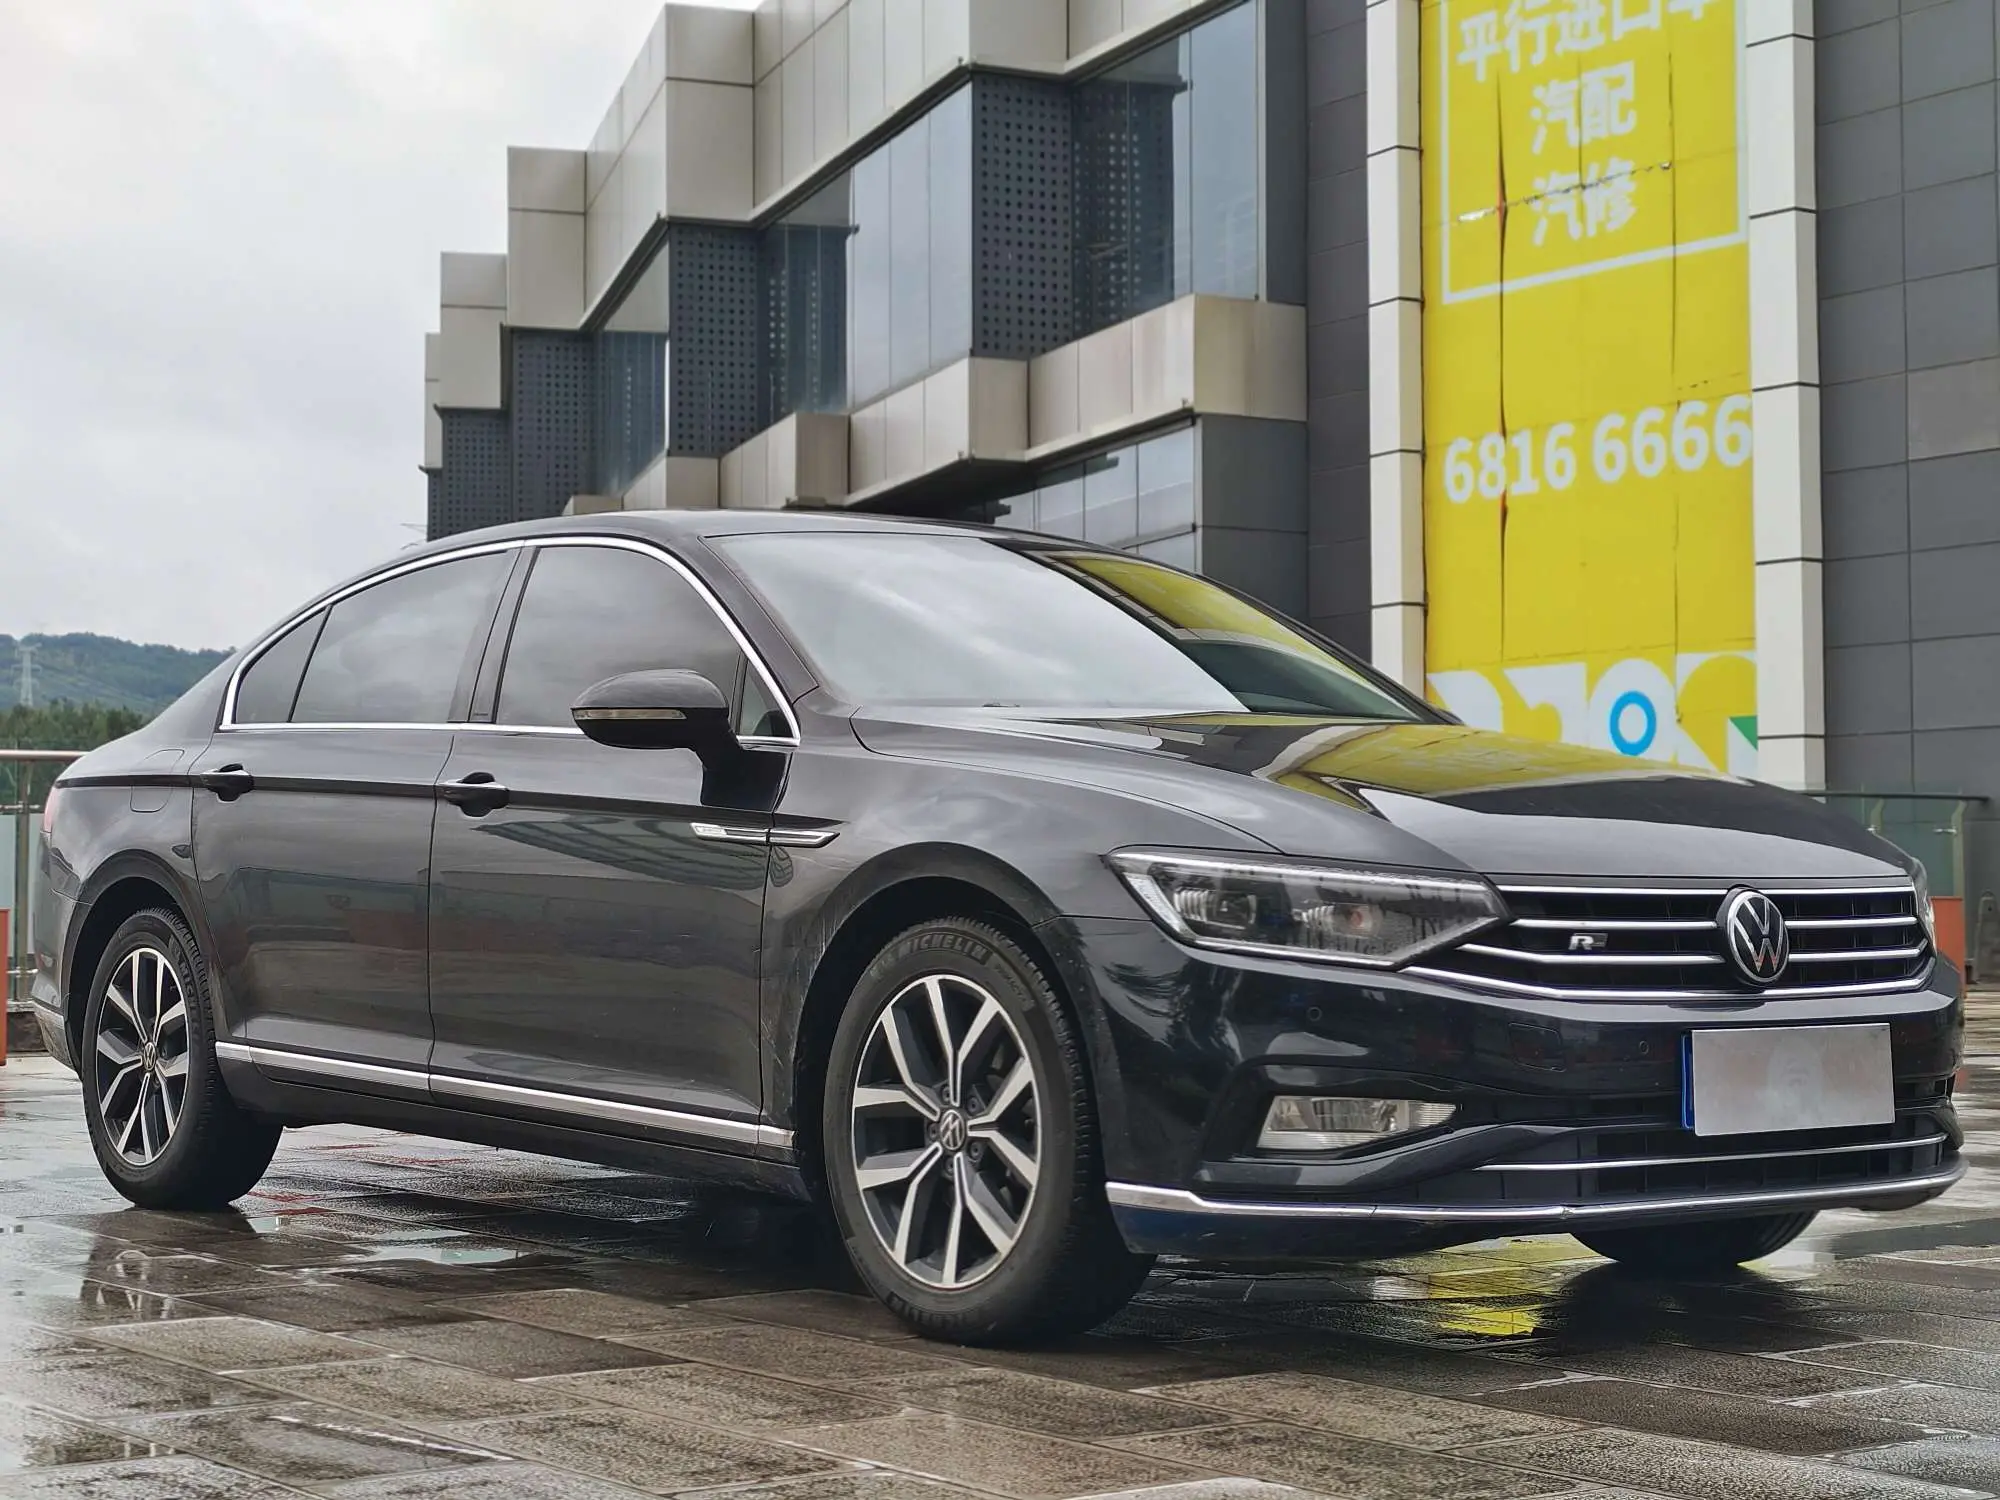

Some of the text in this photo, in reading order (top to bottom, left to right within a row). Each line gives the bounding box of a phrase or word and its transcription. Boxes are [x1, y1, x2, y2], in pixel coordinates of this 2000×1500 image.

[1456, 0, 1721, 82] 平行进口
[1530, 59, 1637, 155] 汽配
[1530, 155, 1638, 247] 汽修
[1443, 394, 1753, 504] 6816 6666
